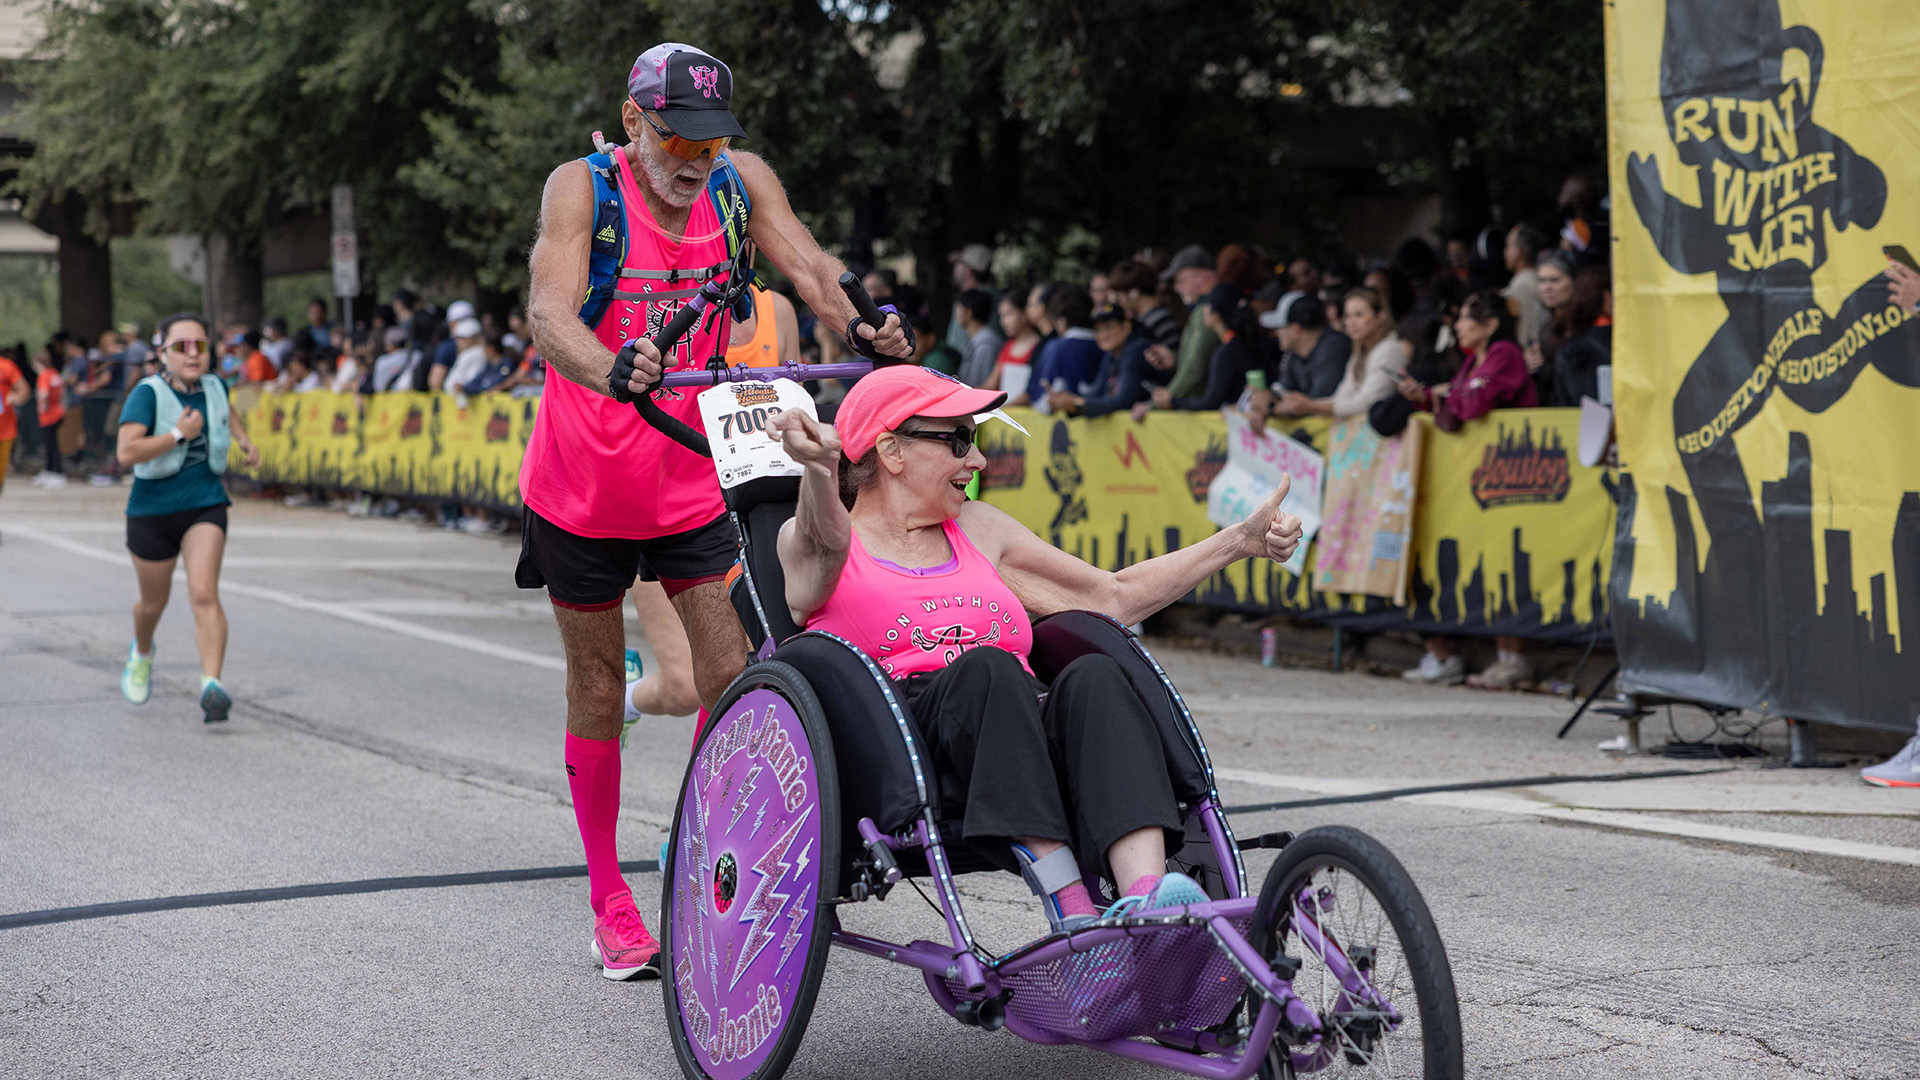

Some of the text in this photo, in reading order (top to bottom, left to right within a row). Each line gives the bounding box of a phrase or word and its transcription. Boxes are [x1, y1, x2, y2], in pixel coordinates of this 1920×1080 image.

[1673, 83, 1799, 163] RUN
[1711, 152, 1838, 227] WITH
[1726, 204, 1816, 271] ME
[1677, 308, 1824, 454] #HOUSTONHALF
[921, 596, 1019, 636] WITHOUT
[701, 704, 807, 813] Team Joanie
[674, 945, 781, 1066] Team Joanie
